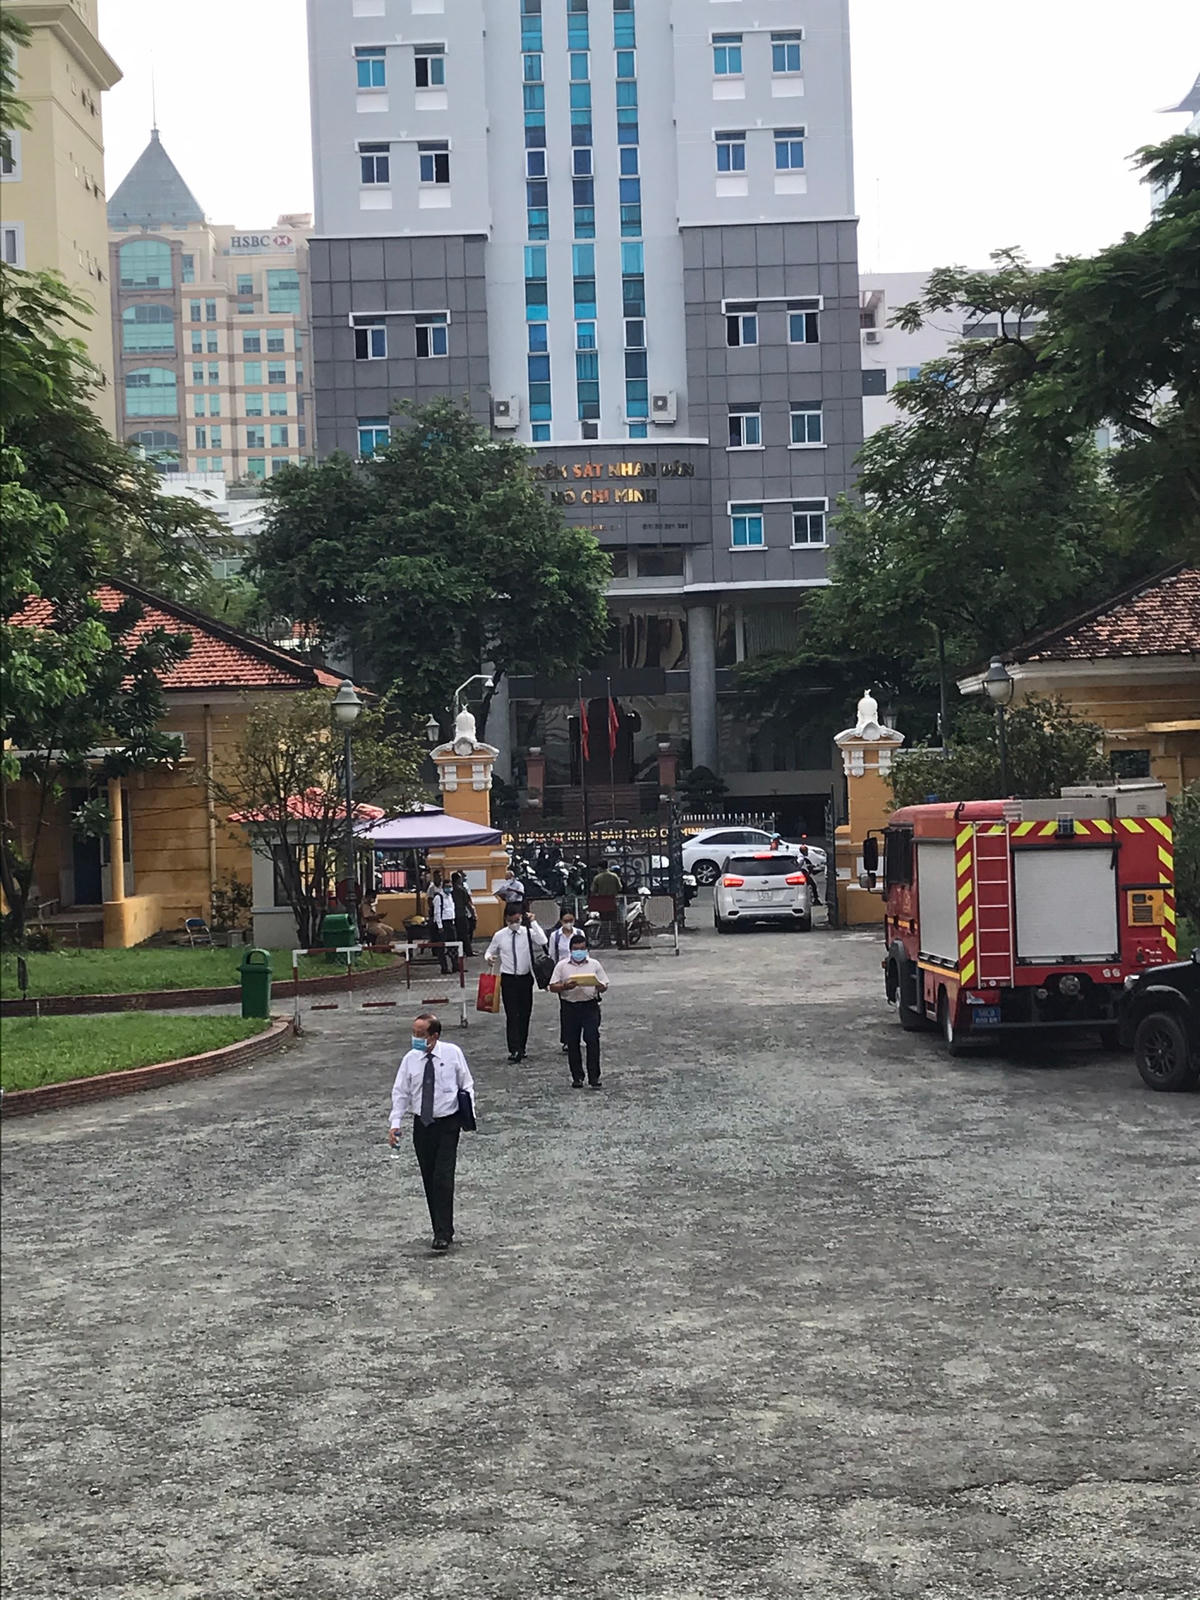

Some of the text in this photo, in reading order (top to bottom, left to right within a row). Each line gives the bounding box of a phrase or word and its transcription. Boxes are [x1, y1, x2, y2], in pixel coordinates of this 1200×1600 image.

[231, 235, 271, 248] HSBC
[572, 460, 604, 479] SÁT
[615, 488, 657, 504] MINH
